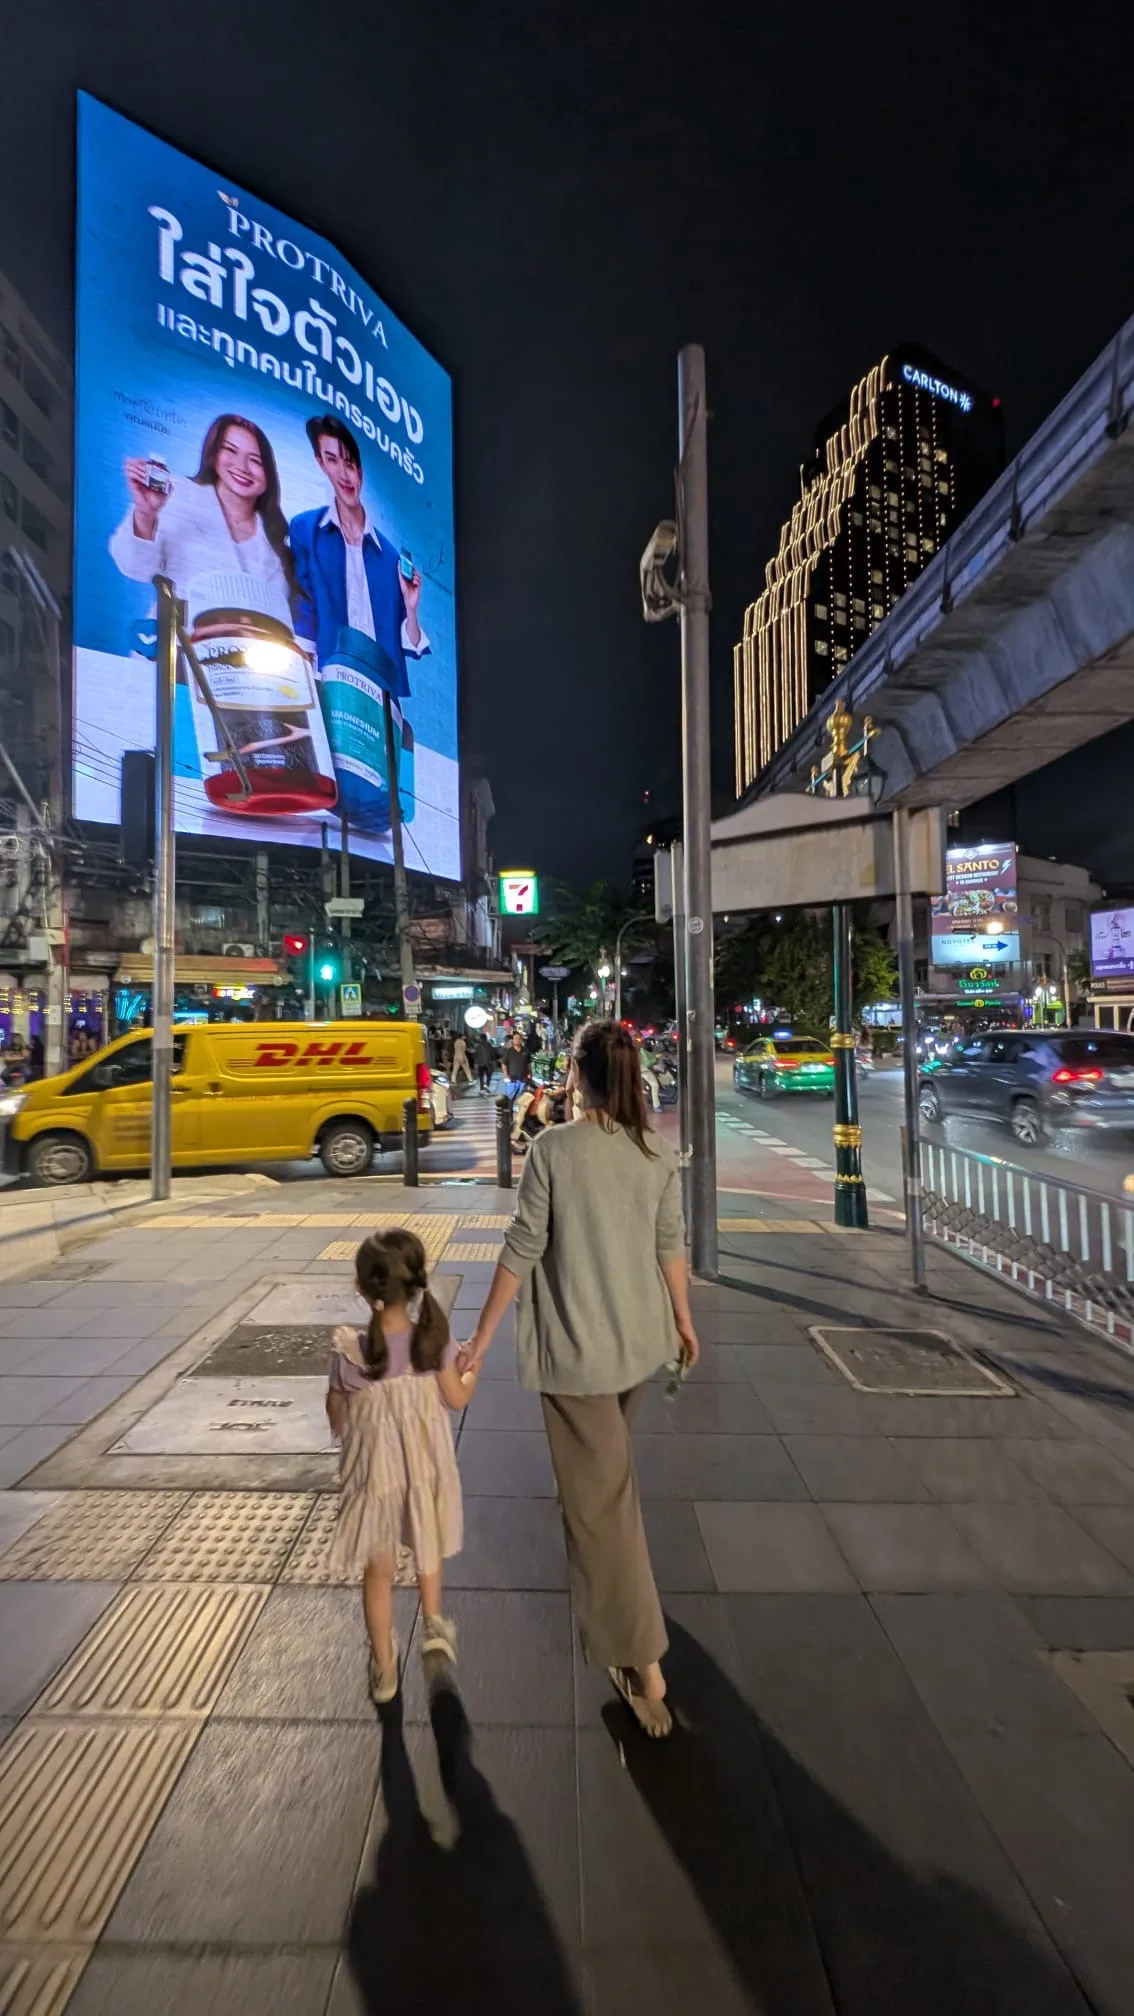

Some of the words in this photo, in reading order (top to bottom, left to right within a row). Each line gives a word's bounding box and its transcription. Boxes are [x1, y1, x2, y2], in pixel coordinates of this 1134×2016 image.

[226, 206, 388, 349] PROTRIVA
[147, 205, 424, 445] ใส่ใจตัวเอง
[157, 302, 425, 485] และทุกคนในครอบครัว
[903, 364, 958, 404] CARLTON
[336, 670, 382, 705] PROTRIVA
[331, 709, 380, 739] MAGNESIUM
[957, 859, 1000, 873] SANTO
[254, 1042, 374, 1067] DHL
